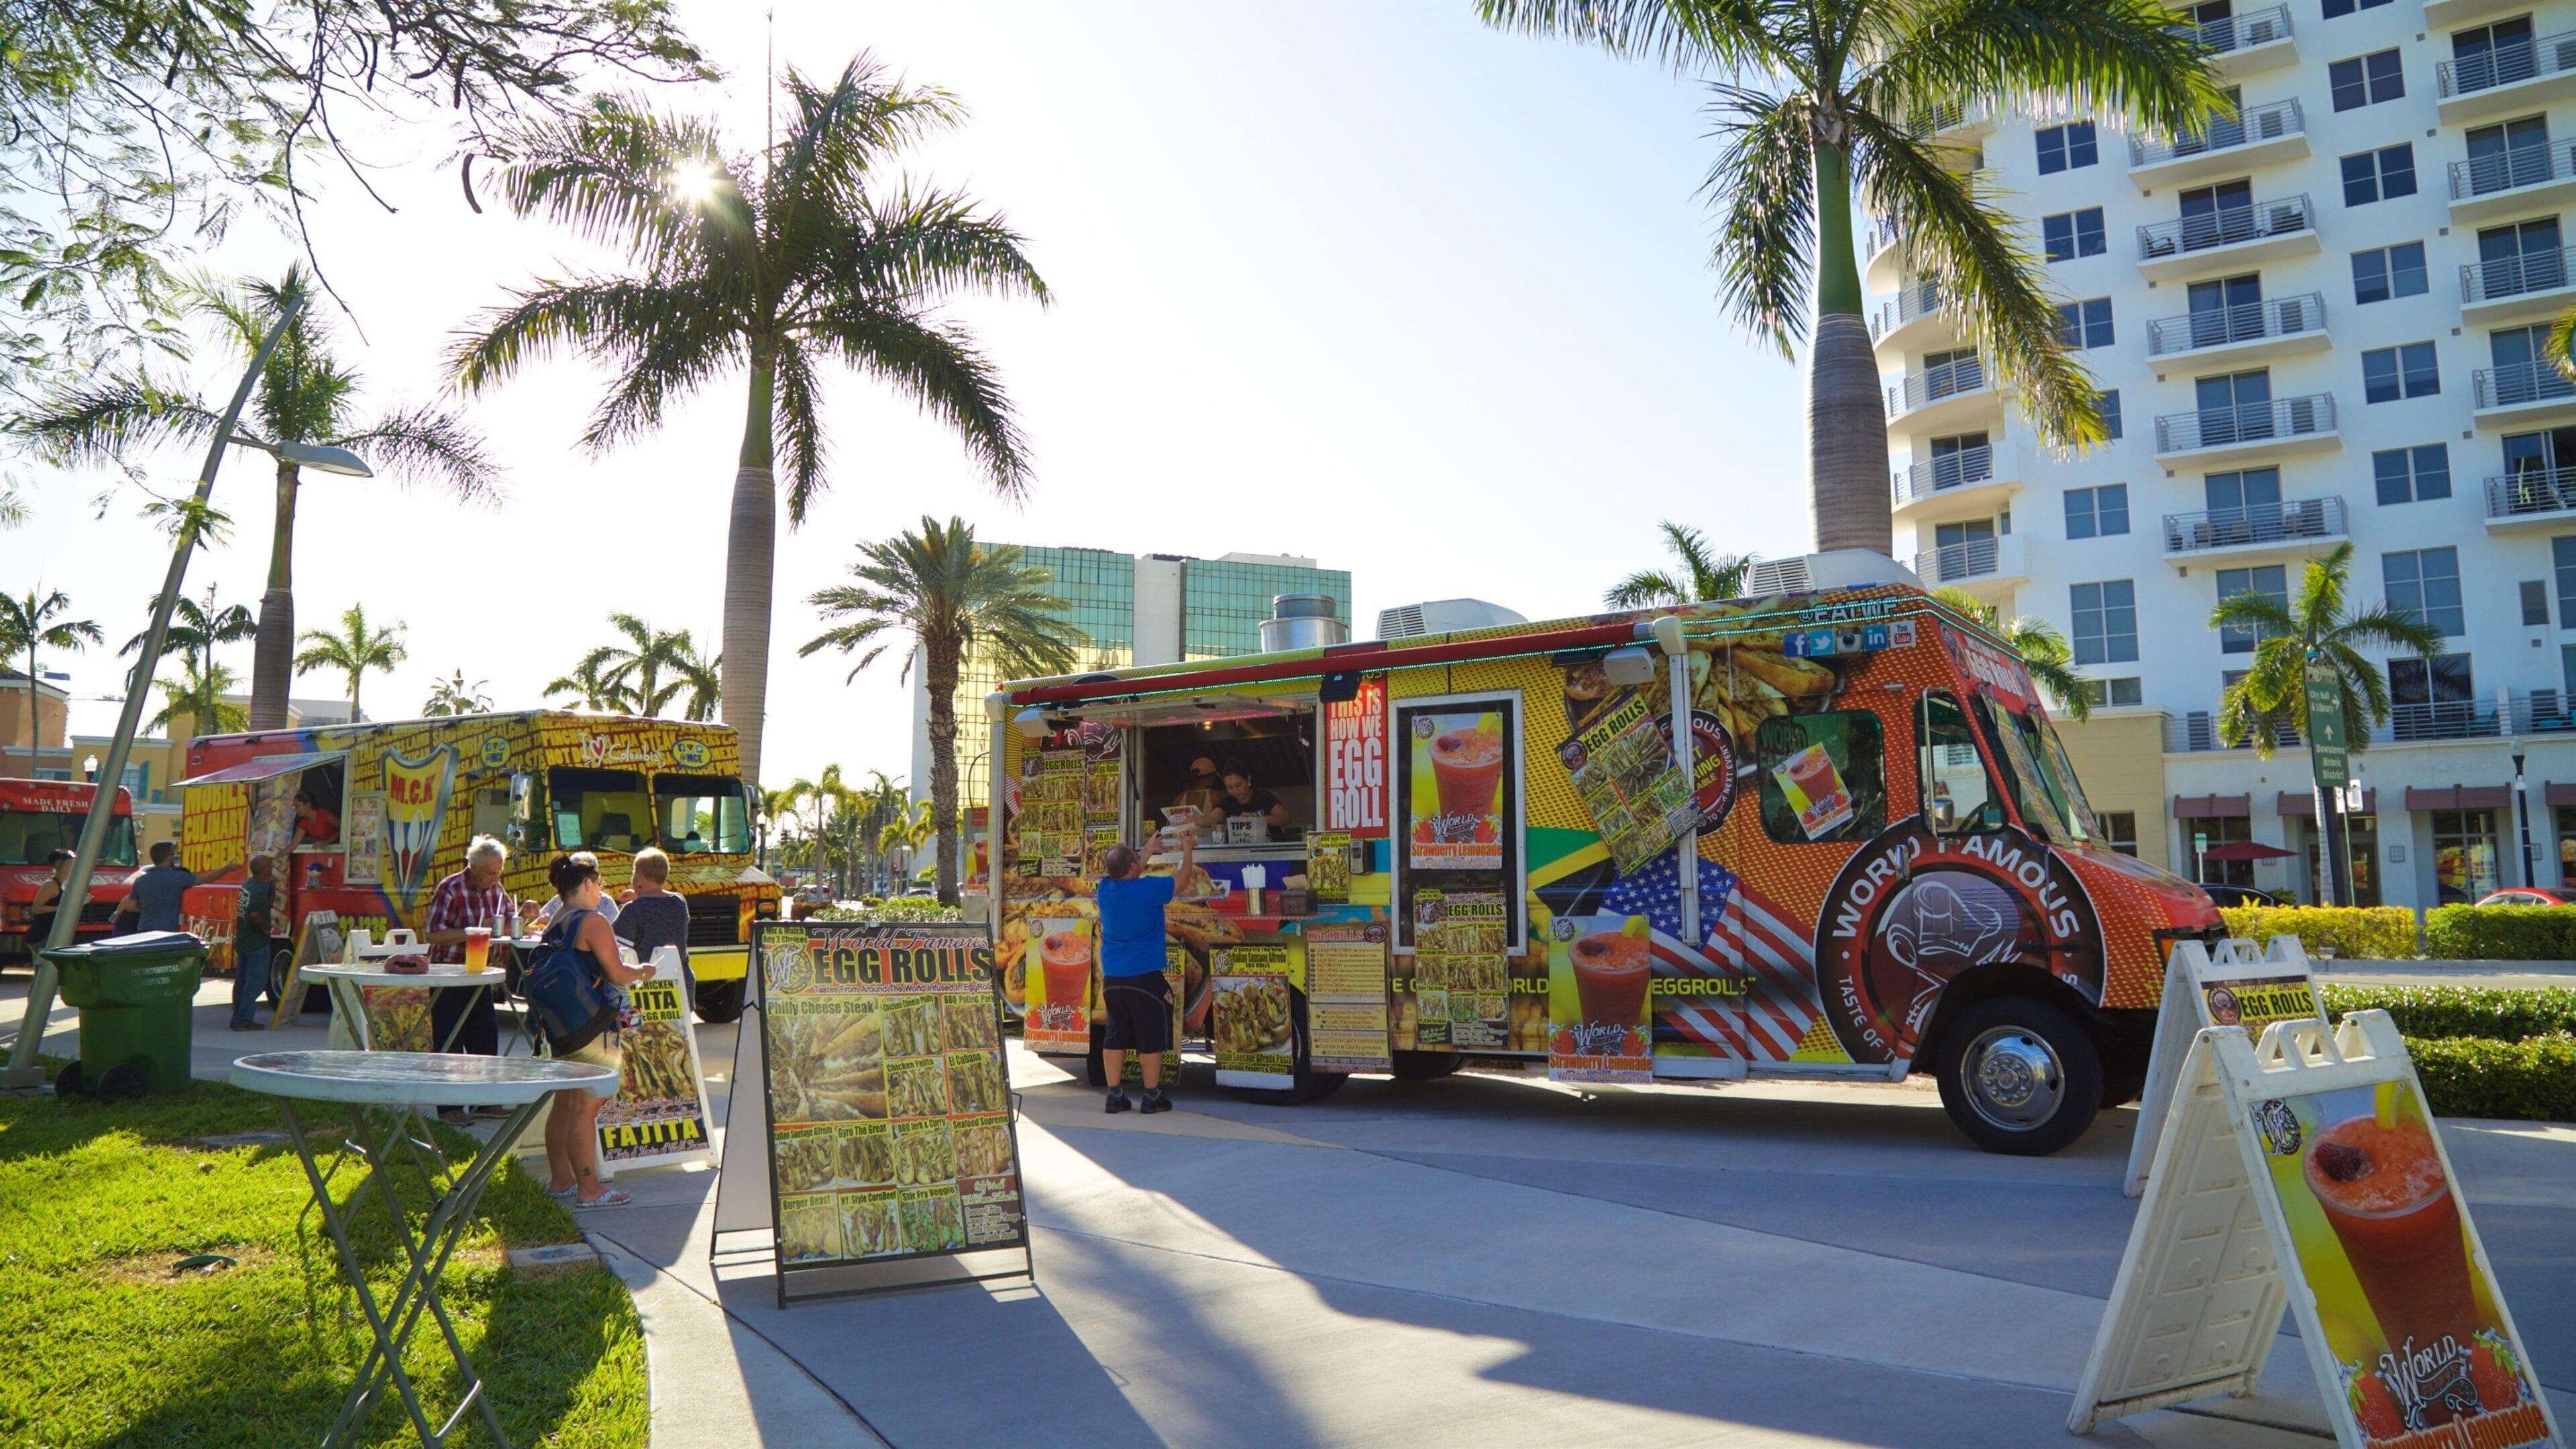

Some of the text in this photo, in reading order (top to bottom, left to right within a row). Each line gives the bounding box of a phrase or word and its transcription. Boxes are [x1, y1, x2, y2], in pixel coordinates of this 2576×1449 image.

[1366, 688, 1382, 715] IS
[2310, 690, 2330, 700] City Hall
[2316, 702, 2334, 714] Library
[1330, 715, 1382, 740] HOW WE
[1584, 700, 1646, 754] EGG ROLLS
[1660, 718, 1721, 740] FOUS
[1719, 744, 1734, 769] EVENT
[2316, 743, 2345, 754] Downtown
[1045, 759, 1083, 771] EGG ROLLS
[1330, 737, 1383, 789] EGG
[2323, 757, 2341, 767] Historic
[1723, 771, 1733, 795] NEXT
[2323, 770, 2345, 780] District
[23, 798, 89, 808] MADE FRESH
[184, 783, 248, 816] MOBILE
[1330, 786, 1383, 828] ROLL
[41, 805, 72, 813] DAILY
[183, 807, 248, 845] CULINARY
[1231, 821, 1252, 830] TIPS
[1432, 810, 1474, 837] WORLD
[1095, 833, 1118, 841] FAJITA
[182, 838, 246, 873] KITCHENS
[1411, 841, 1502, 858] Strawberry Lemonade
[1448, 903, 1503, 916] EGG ROLLS
[782, 936, 808, 944] Choices
[812, 926, 906, 951] World
[900, 927, 989, 951] Famous
[812, 947, 993, 984] EGG ROLLS
[1232, 953, 1286, 963] Italian Sausage Alfredo
[814, 985, 839, 994] Tastes
[840, 985, 859, 994] From
[861, 984, 887, 994] Around
[890, 984, 904, 993] The
[906, 983, 925, 993] World
[927, 983, 953, 992] Infused
[634, 990, 678, 1011] JITA
[944, 995, 957, 1004] BBQ
[959, 994, 979, 1004] Pulled
[2239, 991, 2315, 1018] EGG ROLLS
[660, 1010, 682, 1020] ROLL
[767, 1000, 874, 1016] Philly Cheese Steak
[1839, 975, 1885, 1048] TASTE OF
[1574, 1020, 1622, 1048] WORLD
[886, 1058, 934, 1073] Chicken Fajita
[949, 1053, 982, 1066] El Cubano
[1161, 1053, 1178, 1065] eese
[1216, 1052, 1292, 1064] Italian Sausage Alfredo Pasta
[1550, 1053, 1652, 1072] Strawberry Lemonade
[838, 1123, 888, 1138] Gyro The Great
[898, 1124, 910, 1132] BBQ
[911, 1121, 923, 1131] Jerk
[929, 1118, 946, 1128] Curry
[953, 1115, 1009, 1130] Seafood Supreme
[604, 1117, 700, 1149] FAJITA
[774, 1125, 833, 1141] talian Sausage Alfredo
[841, 1189, 897, 1205] NY Style CornBeef
[902, 1190, 916, 1202] Stir
[917, 1188, 929, 1200] Fry
[929, 1185, 955, 1197] Veggie
[782, 1195, 830, 1211] Burger Beast
[2379, 1334, 2457, 1412] WORLD
